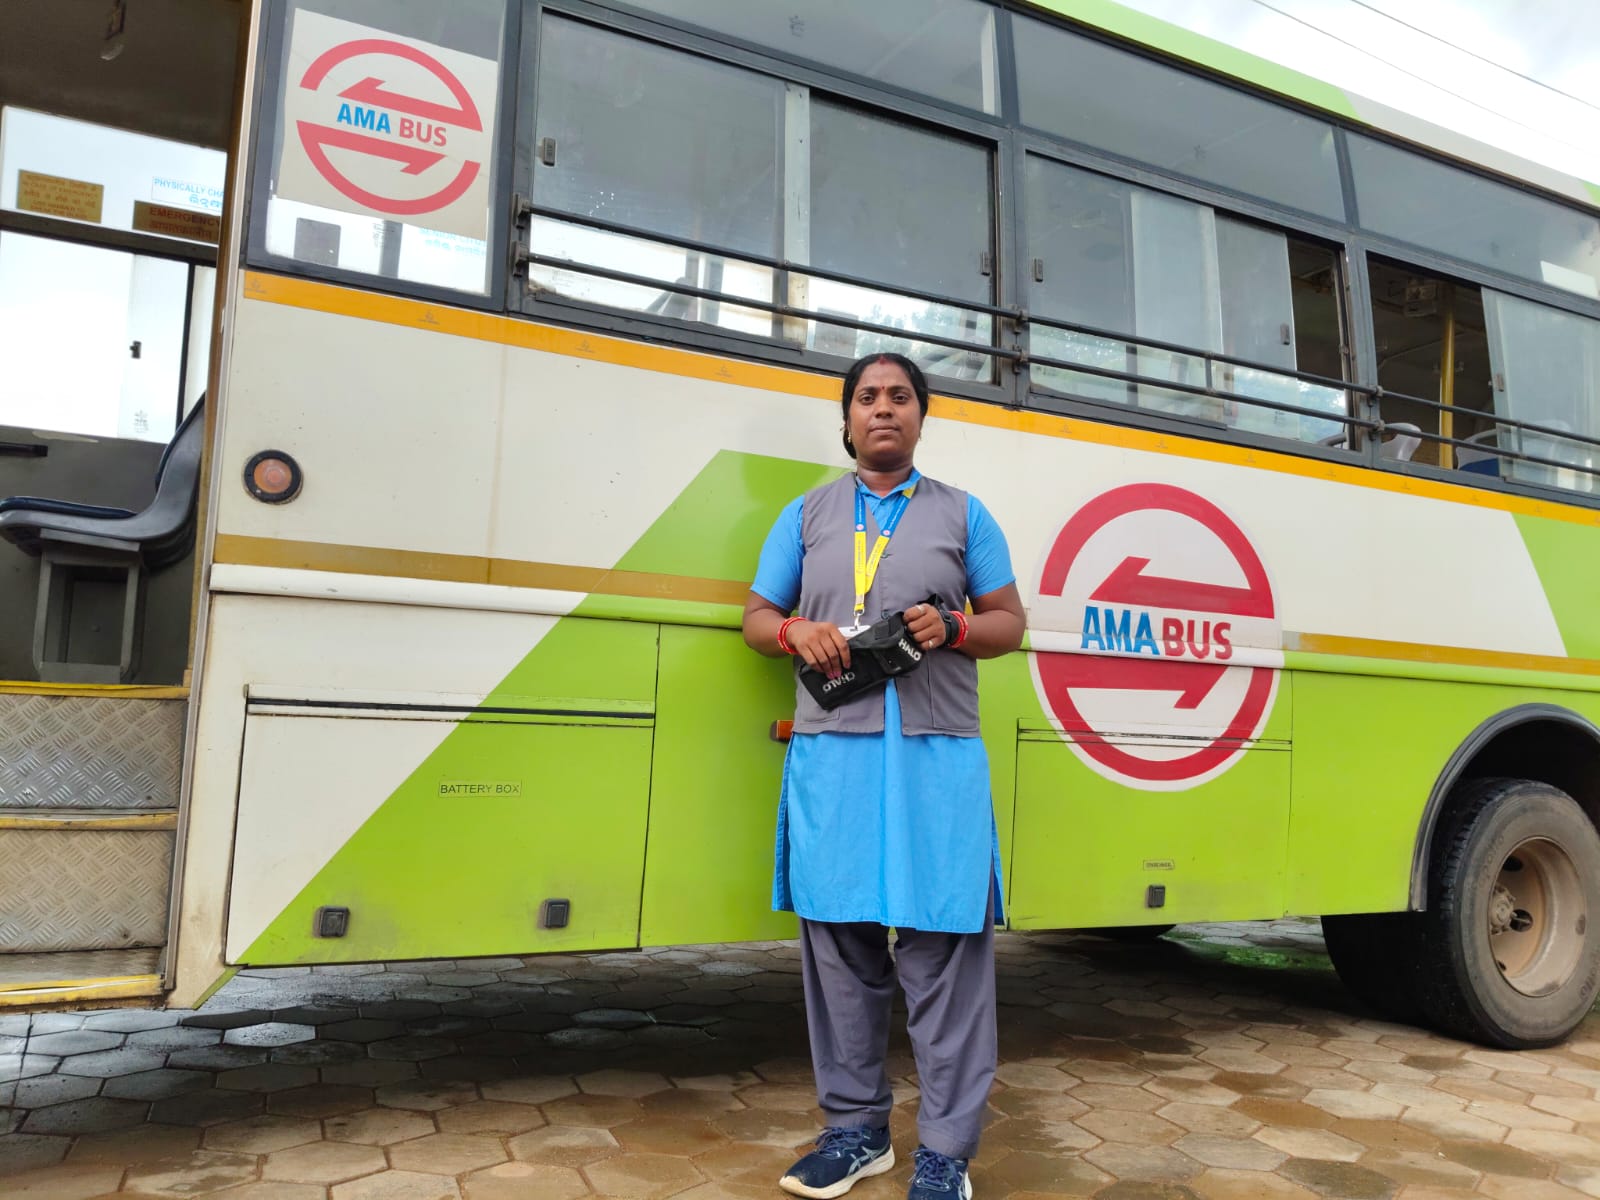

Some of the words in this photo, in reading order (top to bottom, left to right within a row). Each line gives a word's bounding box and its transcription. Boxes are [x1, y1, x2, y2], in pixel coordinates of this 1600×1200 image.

[337, 103, 391, 134] AMA
[399, 117, 447, 147] BUS
[153, 177, 206, 194] PHYSICALLY
[1081, 605, 1160, 656] AMA
[1162, 617, 1233, 660] BUS
[440, 784, 492, 794] BATTERY
[496, 784, 520, 794] BOX
